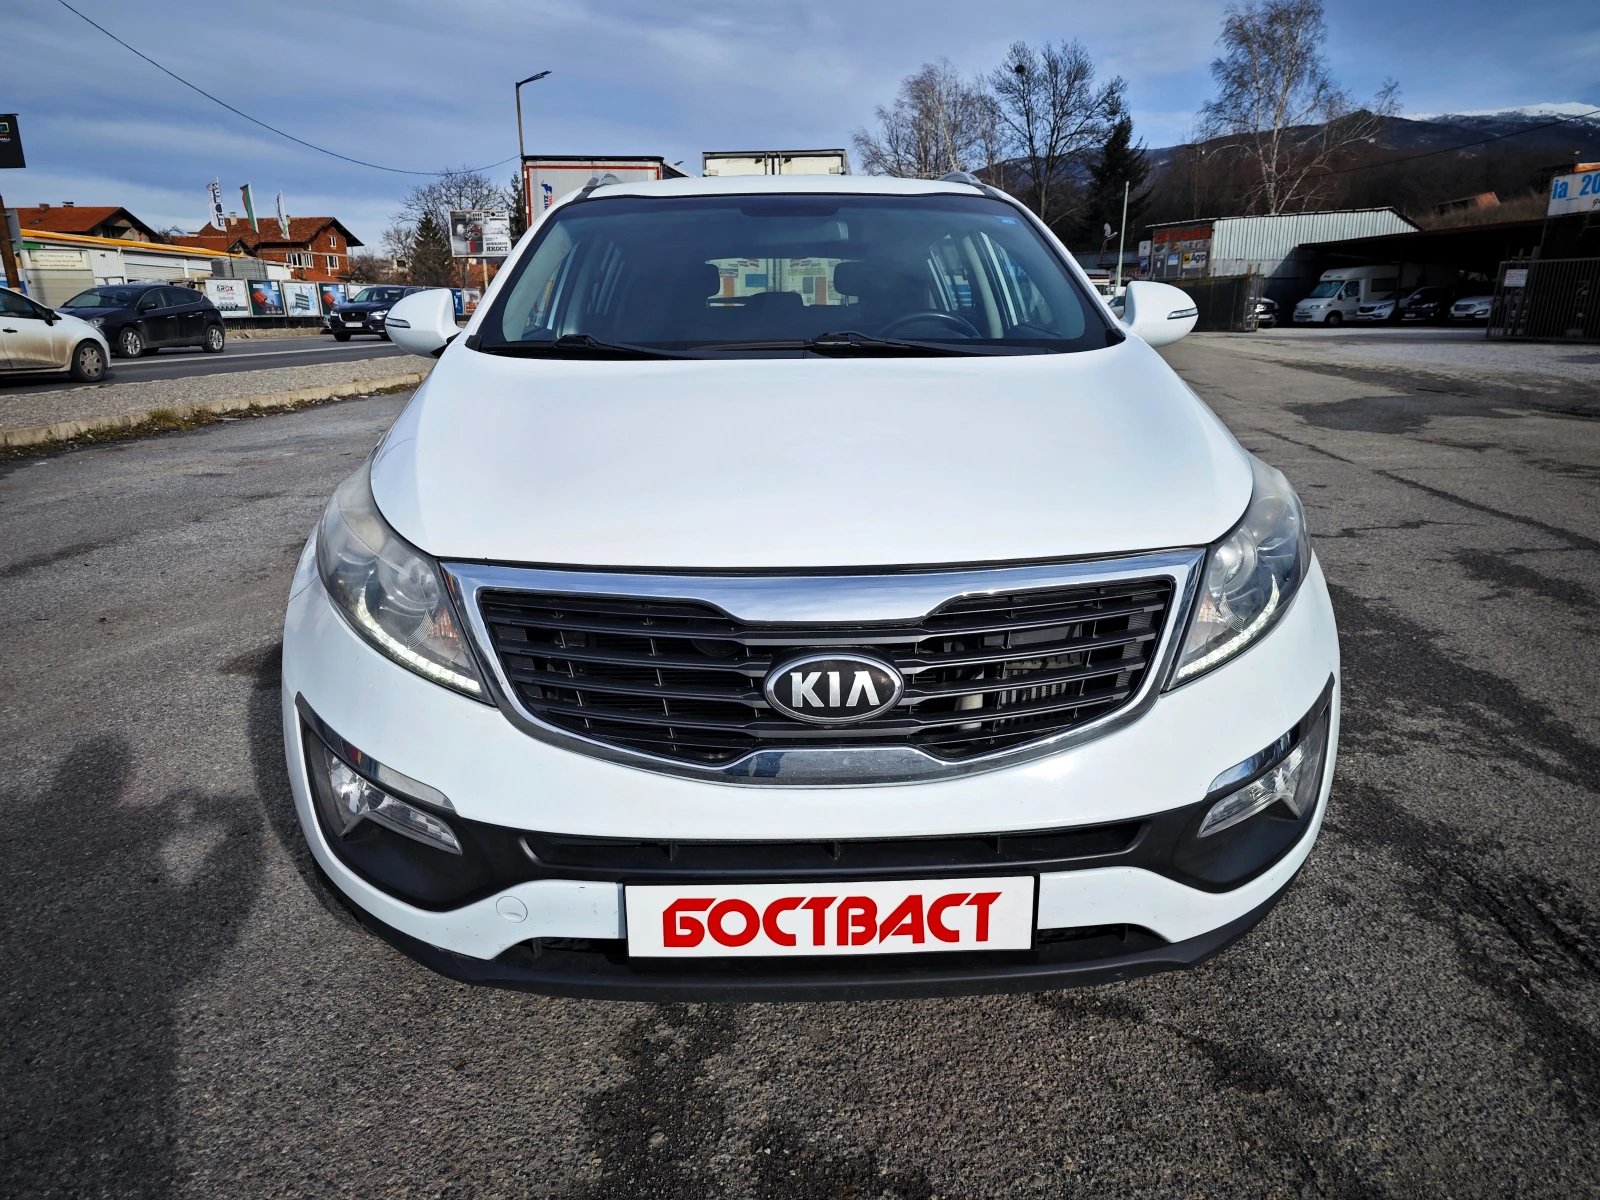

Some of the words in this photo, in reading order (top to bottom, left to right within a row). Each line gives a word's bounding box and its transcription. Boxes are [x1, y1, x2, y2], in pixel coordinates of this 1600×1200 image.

[1155, 227, 1209, 244] СЕРВИЗ
[790, 671, 880, 708] KIA
[663, 892, 1003, 948] БОСТВАСТ
